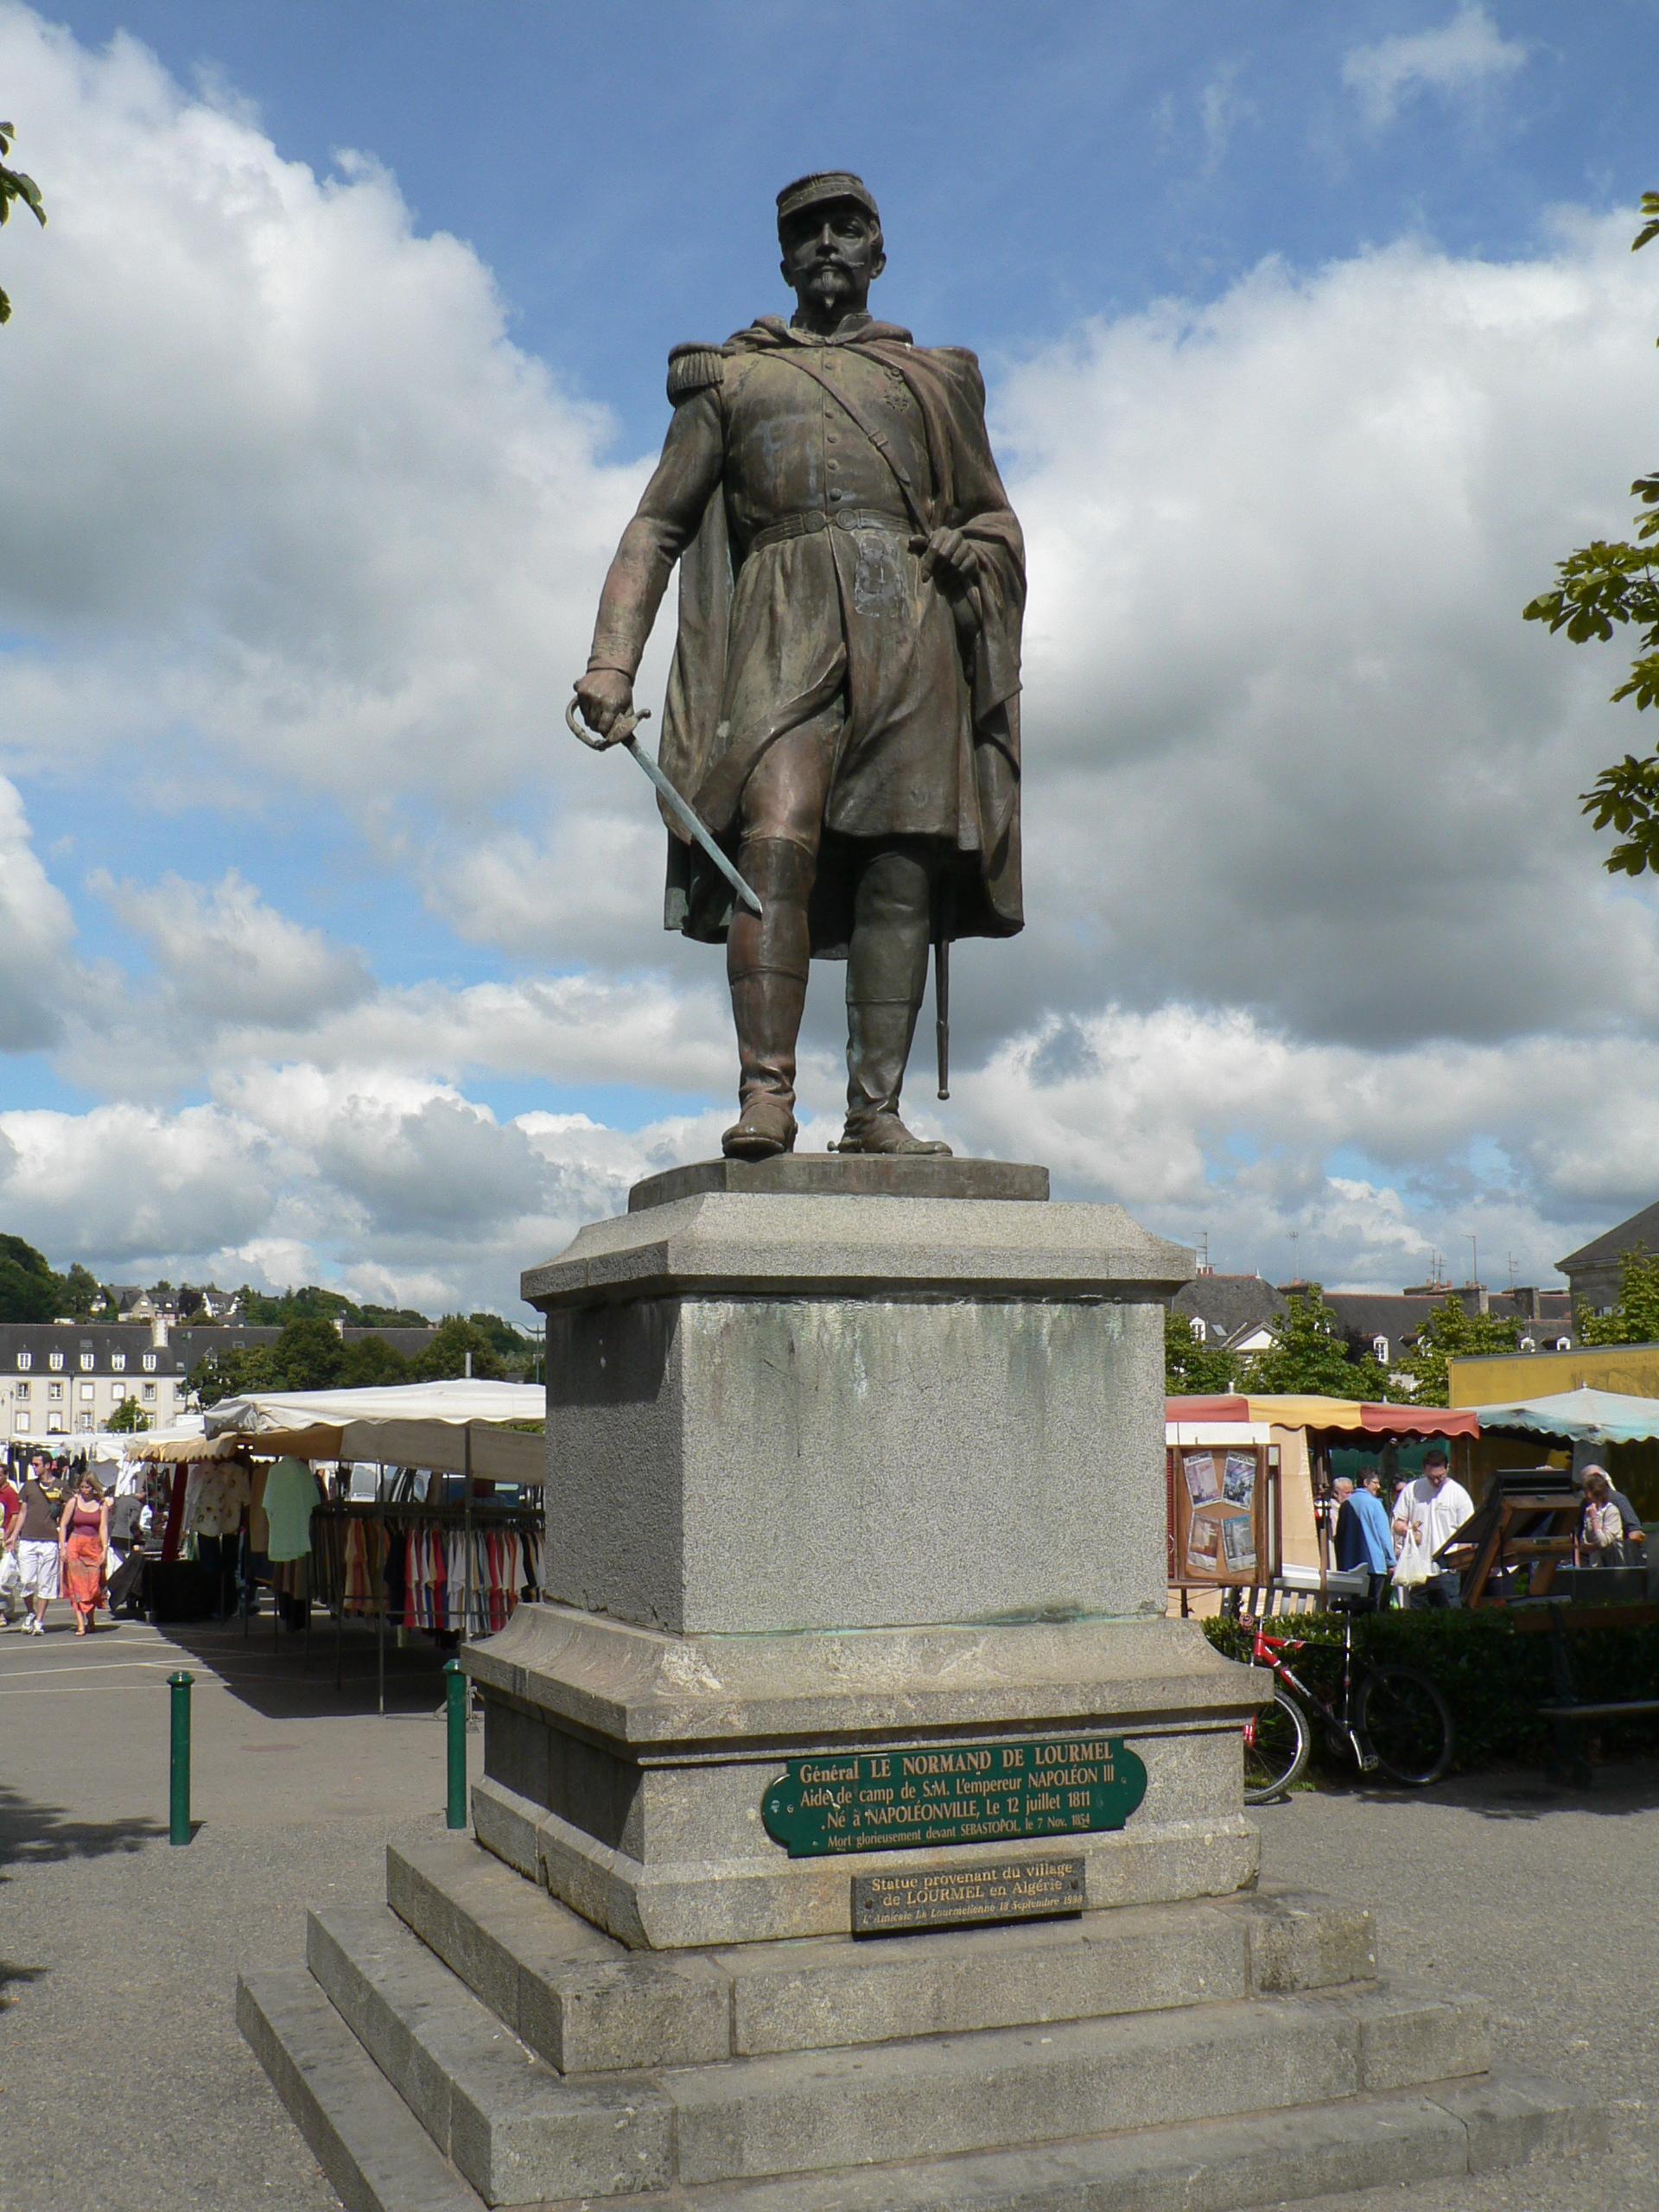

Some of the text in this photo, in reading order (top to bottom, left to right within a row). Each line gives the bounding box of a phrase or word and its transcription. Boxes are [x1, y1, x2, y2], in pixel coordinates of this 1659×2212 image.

[800, 1742, 1113, 1783] Général LE NORMAND DE LOURMEL
[801, 1764, 1115, 1807] Aide de camp de S.M. L'empereur NAPOLÉON III
[827, 1790, 1090, 1829] Né à NAPOLÉONVILLE, Le 12 juillet 1811
[828, 1834, 851, 1847] Mort
[856, 1829, 922, 1848] glorieusement
[926, 1826, 956, 1840] devant
[1025, 1818, 1033, 1831] le
[1038, 1818, 1043, 1828] 7
[1047, 1816, 1067, 1828] Nov.
[1071, 1813, 1090, 1826] 1854
[872, 1863, 1073, 1892] Statue provenant du village
[883, 1878, 1063, 1907] de LOURMEL en Algérie
